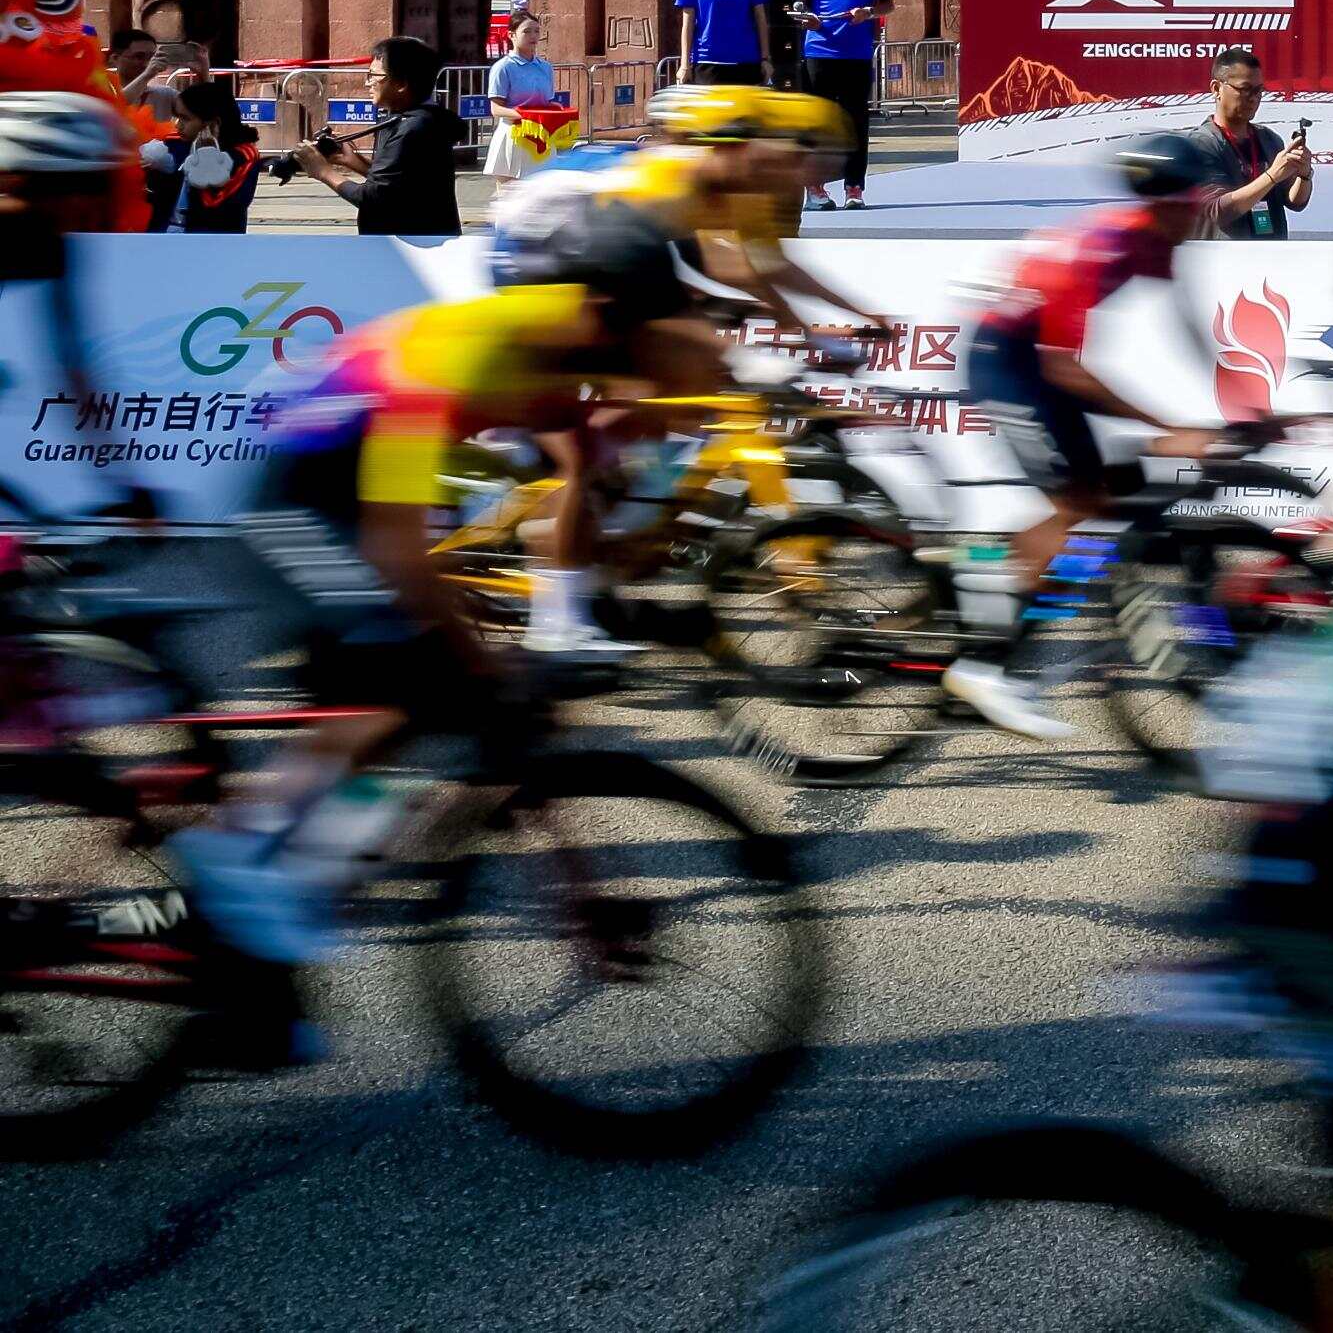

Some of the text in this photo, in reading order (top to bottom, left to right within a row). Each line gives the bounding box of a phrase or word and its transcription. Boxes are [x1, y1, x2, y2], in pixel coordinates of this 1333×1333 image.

[1082, 42, 1192, 58] ZENGCHENG
[345, 113, 374, 121] POLICE
[24, 437, 179, 468] Guangzhou
[1168, 504, 1262, 517] GUANGZHOU
